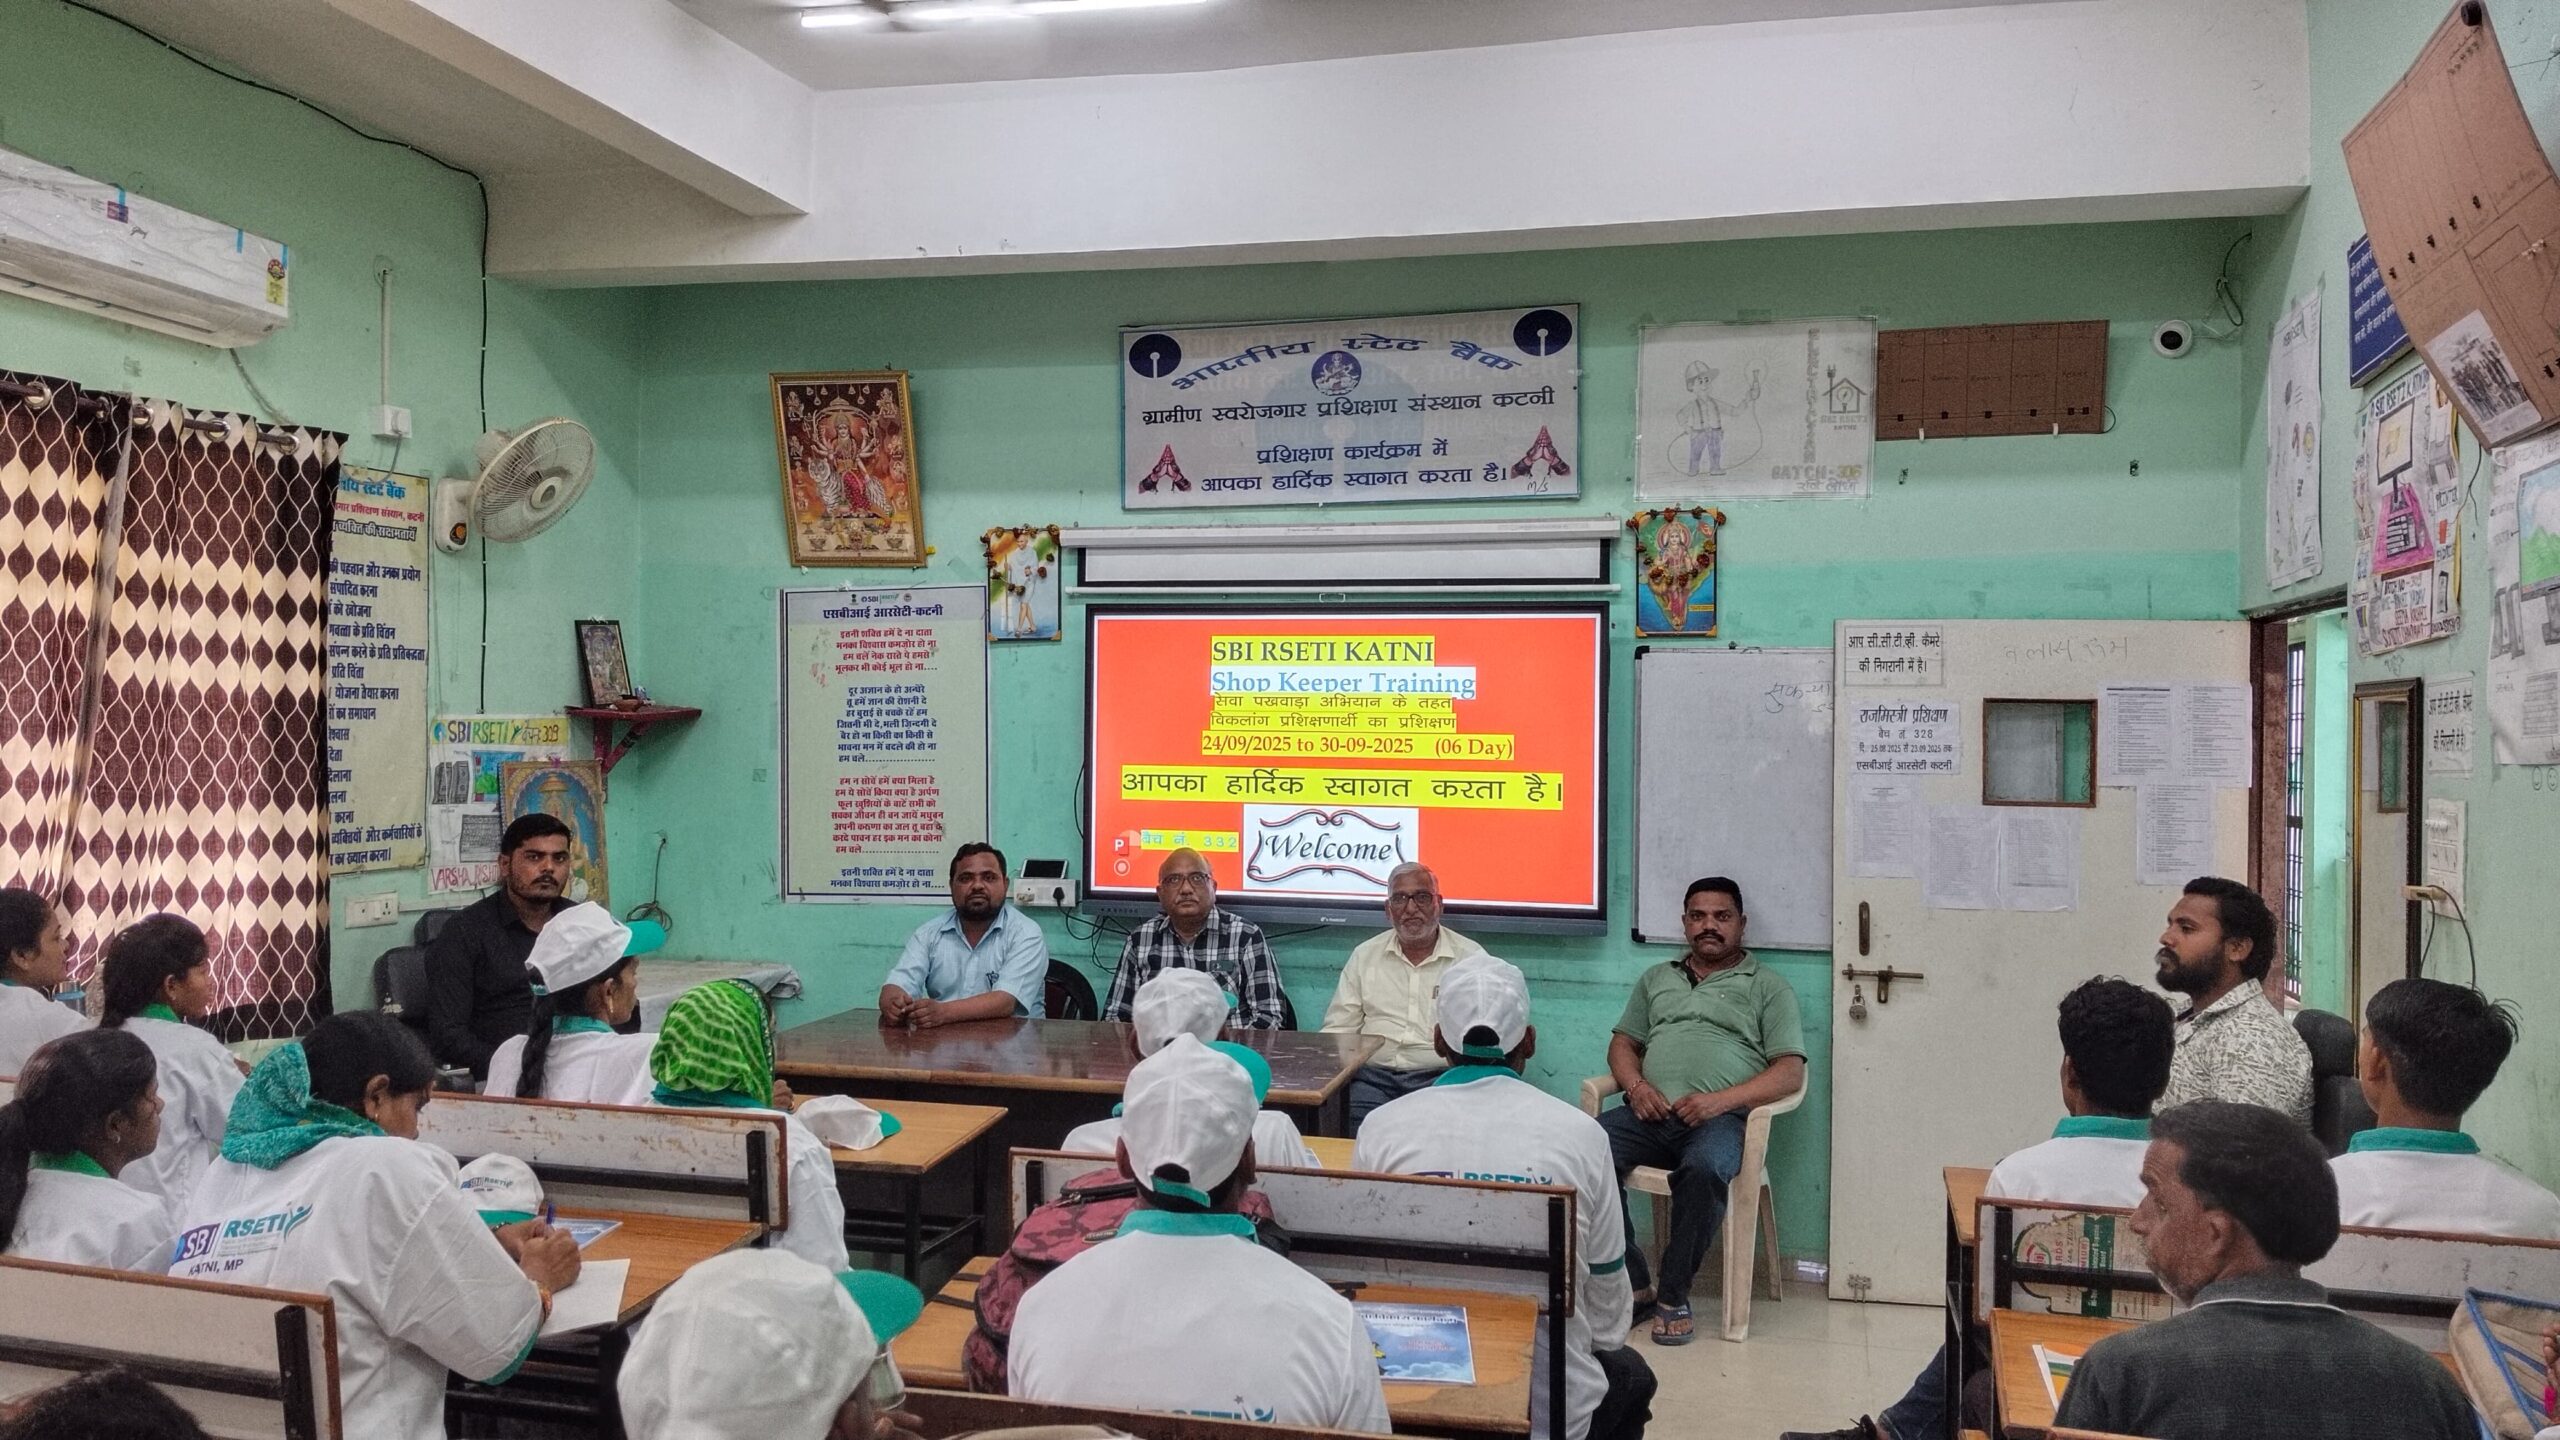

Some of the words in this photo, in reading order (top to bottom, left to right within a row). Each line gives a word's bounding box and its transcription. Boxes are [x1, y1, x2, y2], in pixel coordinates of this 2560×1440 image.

[1341, 333, 1428, 351] स्टेट
[1142, 404, 1202, 425] ग्रामीण
[1212, 401, 1307, 421] स्वरोजगार
[1317, 397, 1398, 417] प्रशिक्षण
[1408, 394, 1482, 412] संस्थान
[1492, 385, 1555, 407] कटनी
[1257, 445, 1334, 464] प्रशिक्षण
[1344, 440, 1421, 460] कार्यक्रम
[1433, 438, 1448, 456] में
[1201, 476, 1262, 491] आपका
[1272, 470, 1333, 489] हार्दिक
[1344, 471, 1408, 486] स्वागत
[1419, 469, 1472, 483] करता
[823, 606, 871, 618] एसबीआई
[874, 604, 943, 617] आरसेटी-कटनी
[1849, 636, 1864, 647] आप
[1922, 632, 1940, 647] कैमरे
[1213, 642, 1253, 661] SBI
[1261, 642, 1336, 661] RSETI
[1344, 642, 1433, 661] KATNI
[1859, 657, 1870, 672] की
[1874, 657, 1904, 672] निगरानी
[1212, 672, 1271, 692] Shop
[1278, 672, 1363, 693] Keeper
[1369, 672, 1475, 699] Training
[1215, 691, 1244, 707] सेवा
[1254, 697, 1310, 709] पखवाड़ा
[1320, 693, 1381, 708] अभियान
[1392, 693, 1407, 708] के
[1419, 698, 1451, 709] तहत
[1211, 711, 1270, 726] विकलांग
[1280, 712, 1358, 727] प्रशिक्षणार्थी
[1368, 717, 1388, 727] का
[1398, 713, 1456, 729] प्रशिक्षण
[1860, 704, 1907, 723] राजमिस्त्री
[1912, 704, 1948, 724] प्रशिक्षण
[448, 720, 471, 743] SBI
[472, 720, 509, 744] RSETI
[1914, 729, 1933, 739] 328
[1202, 735, 1291, 755] 24/09/2025
[1297, 737, 1314, 752] to
[1320, 737, 1413, 753] 30-09-2025
[1435, 739, 1462, 758] (06
[1468, 739, 1513, 760] Day)
[1856, 759, 1892, 772] एसबीआई
[1896, 759, 1927, 771] आरसेटी
[1931, 760, 1952, 771] कटनी
[1122, 773, 1207, 792] आपका
[1225, 768, 1304, 795] हार्दिक
[1323, 777, 1412, 797] स्वागत
[1431, 779, 1506, 799] करता
[1265, 832, 1391, 860] Welcome
[182, 1227, 217, 1259] SBI
[223, 1213, 288, 1238] RSETI
[188, 1261, 220, 1276] KATNI,
[224, 1259, 244, 1271] MP
